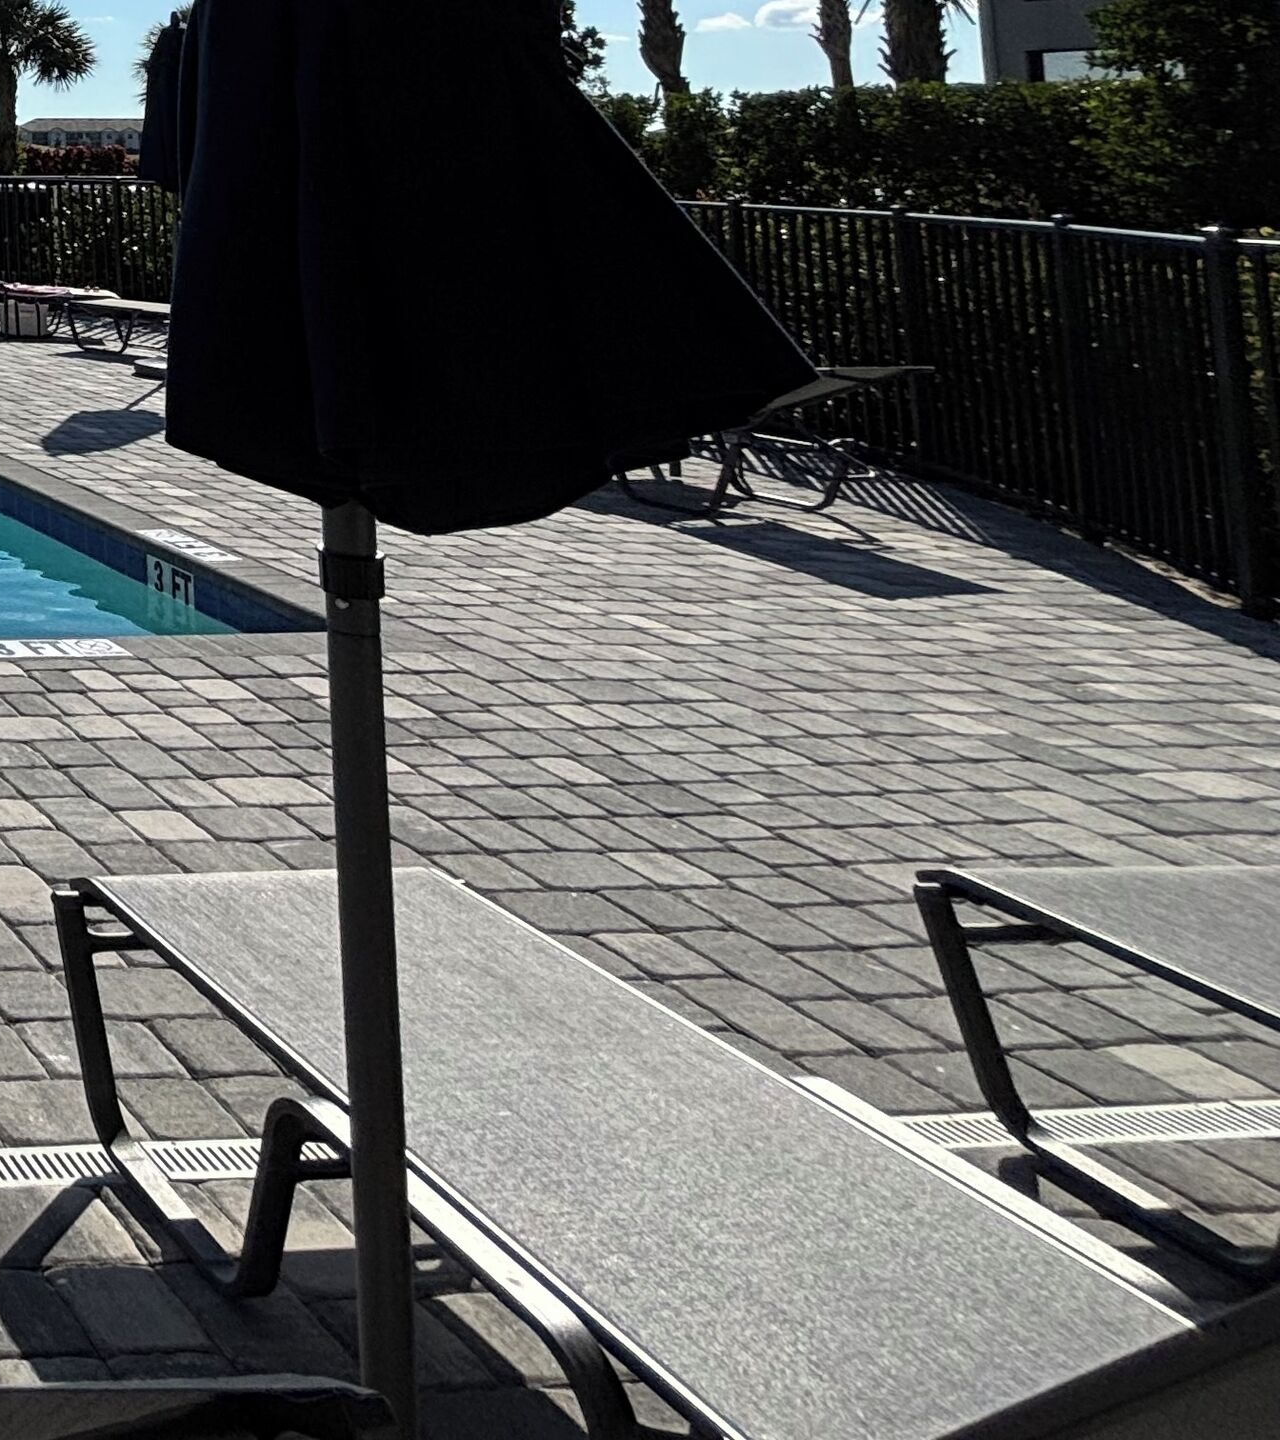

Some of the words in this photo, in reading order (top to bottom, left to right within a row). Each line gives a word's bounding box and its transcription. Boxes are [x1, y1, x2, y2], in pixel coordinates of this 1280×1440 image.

[153, 560, 164, 593] 3
[171, 568, 192, 606] FT
[18, 640, 71, 655] FT
